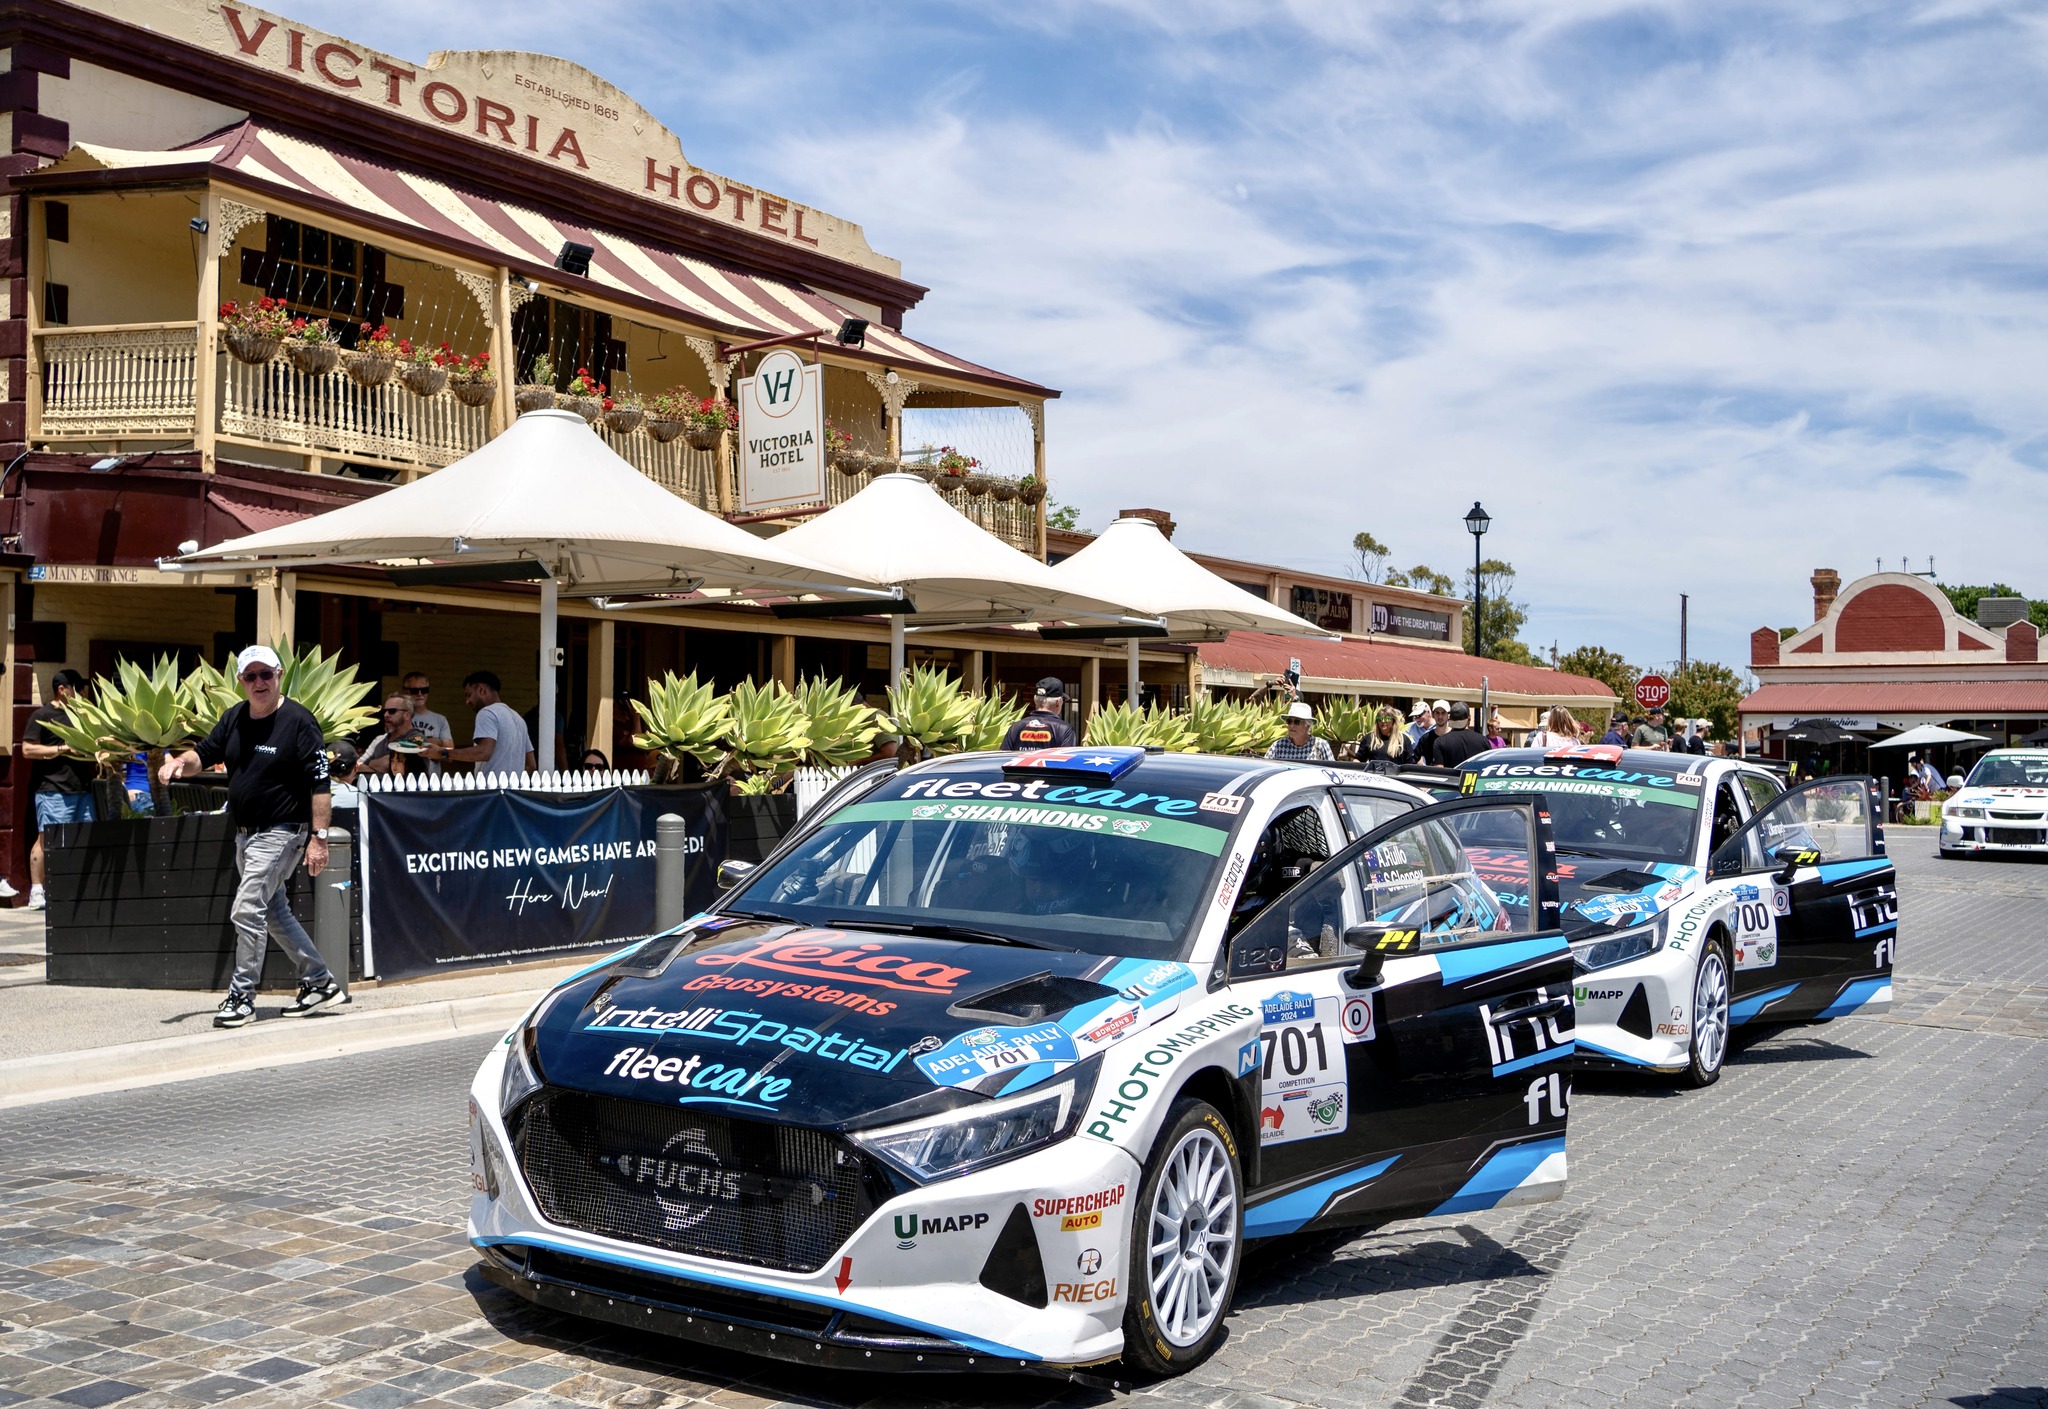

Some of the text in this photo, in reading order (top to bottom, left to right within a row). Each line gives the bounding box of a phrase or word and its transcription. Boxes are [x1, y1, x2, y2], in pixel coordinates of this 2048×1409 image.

[515, 74, 619, 121] ESTABLISHED 1865
[221, 5, 818, 247] VICTORIA HOTEL
[762, 368, 795, 405] VH
[749, 430, 814, 454] VICTORIA
[760, 448, 804, 468] HOTEL
[1390, 615, 1447, 632] LIVE THE DREAM TRAVEL
[1637, 685, 1668, 699] STOP
[1480, 764, 1675, 787] fleetcare
[1508, 780, 1614, 796] SHANNONS
[901, 778, 1198, 817] fleetcare
[1206, 795, 1239, 808] 701
[944, 805, 1108, 831] SHANNONS
[406, 849, 489, 874] EXCITING
[493, 847, 532, 867] NEW
[536, 845, 590, 866] GAMES
[593, 841, 632, 861] HAVE
[506, 873, 614, 916] Here Now!
[1583, 901, 1623, 916] ADELAIDE
[1616, 904, 1638, 914] 700
[695, 931, 972, 994] Leica
[1144, 961, 1181, 986] calder
[682, 973, 898, 1017] Geosystems
[1264, 998, 1312, 1014] ADELAIDE RALLY
[1281, 1011, 1297, 1021] 2024
[1656, 1023, 1689, 1035] RIEGL
[928, 1027, 1062, 1075] ADELAIDE RALLY
[985, 1048, 1029, 1069] 701
[1260, 1022, 1327, 1080] 701
[604, 1048, 792, 1102] fleetcare
[1086, 1004, 1254, 1142] PHOTOMAPPING
[1279, 1077, 1315, 1089] COMPETITION
[1524, 1073, 1572, 1125] fl
[637, 1156, 740, 1200] FUCHS
[1033, 1184, 1125, 1217] SUPERCHEAP
[1065, 1215, 1099, 1228] AUTO
[1053, 1278, 1118, 1303] RIEGL
